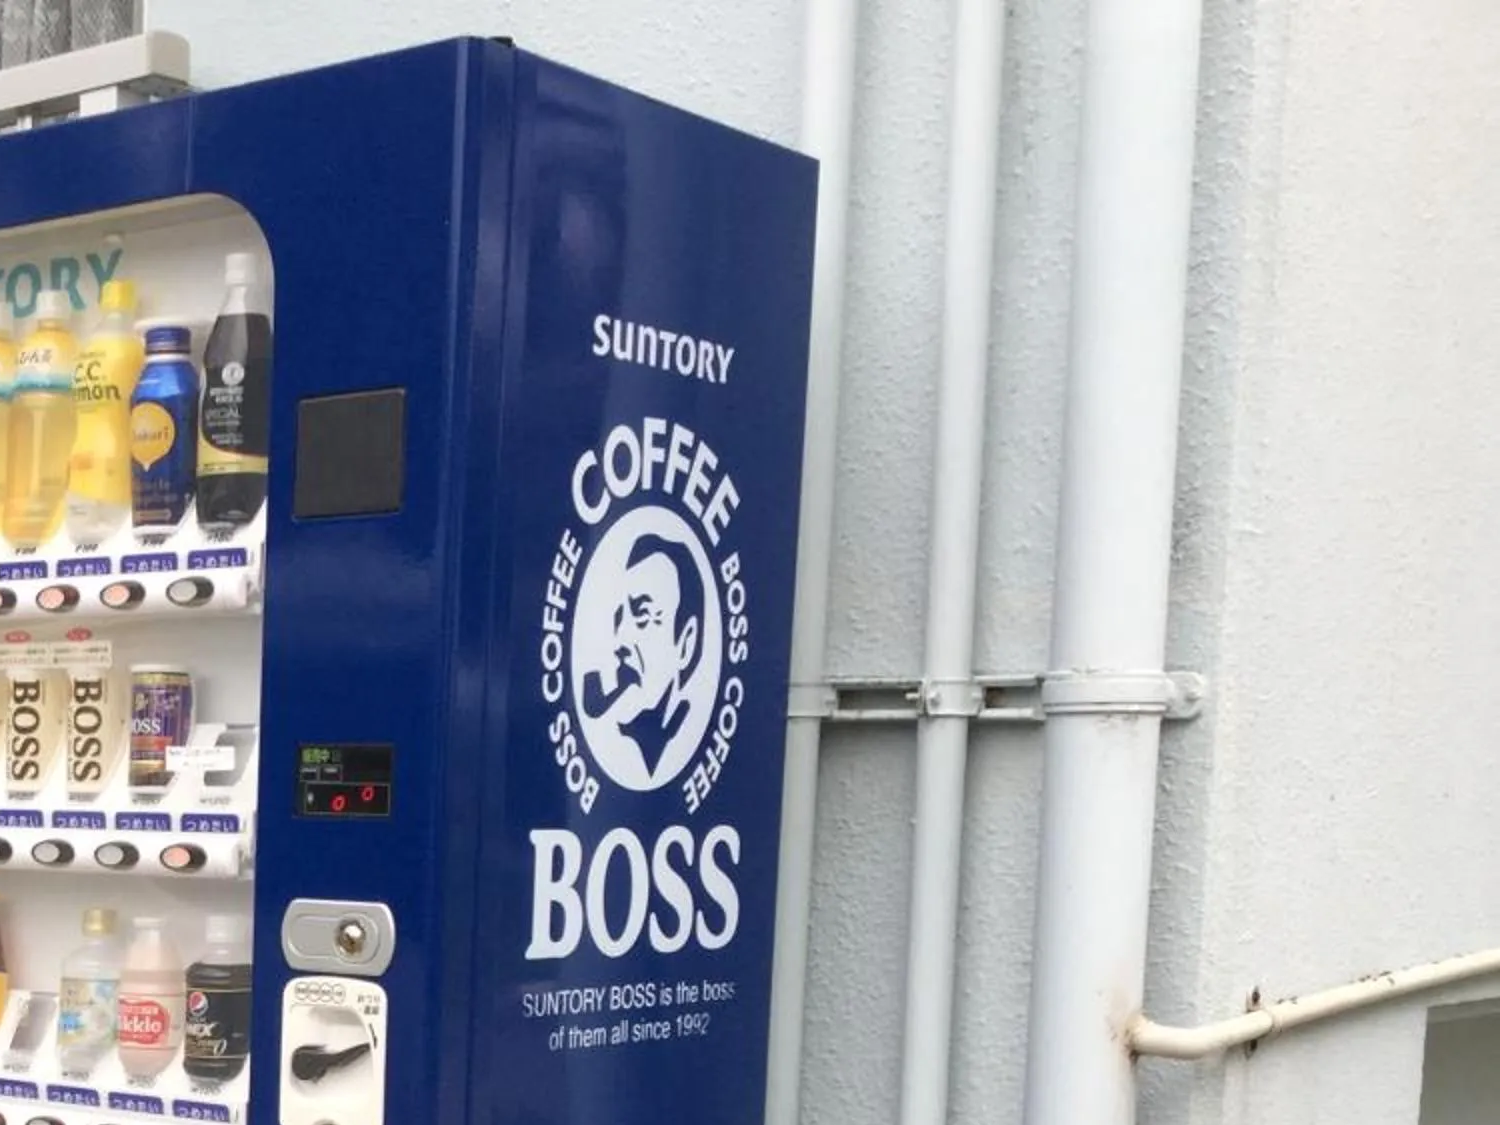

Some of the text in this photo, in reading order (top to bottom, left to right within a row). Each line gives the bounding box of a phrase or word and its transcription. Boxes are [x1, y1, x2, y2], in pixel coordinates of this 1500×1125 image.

[72, 384, 122, 401] mon
[592, 313, 735, 384] SUNTORY
[571, 416, 741, 548] COFFEE
[540, 528, 600, 815] BOSS COFFEE
[681, 552, 749, 815] BOSS COFFEE
[11, 680, 41, 782] BOSS
[73, 679, 103, 783] BOSS
[132, 718, 162, 734] OSS
[525, 824, 741, 960] BOSS
[522, 987, 607, 1018] SUNTORY
[609, 982, 657, 1010] BOSS
[660, 982, 673, 1006] is
[676, 981, 699, 1004] the
[548, 1026, 565, 1051] of
[568, 1024, 608, 1049] them
[611, 1020, 629, 1046] all
[632, 1016, 672, 1043] since
